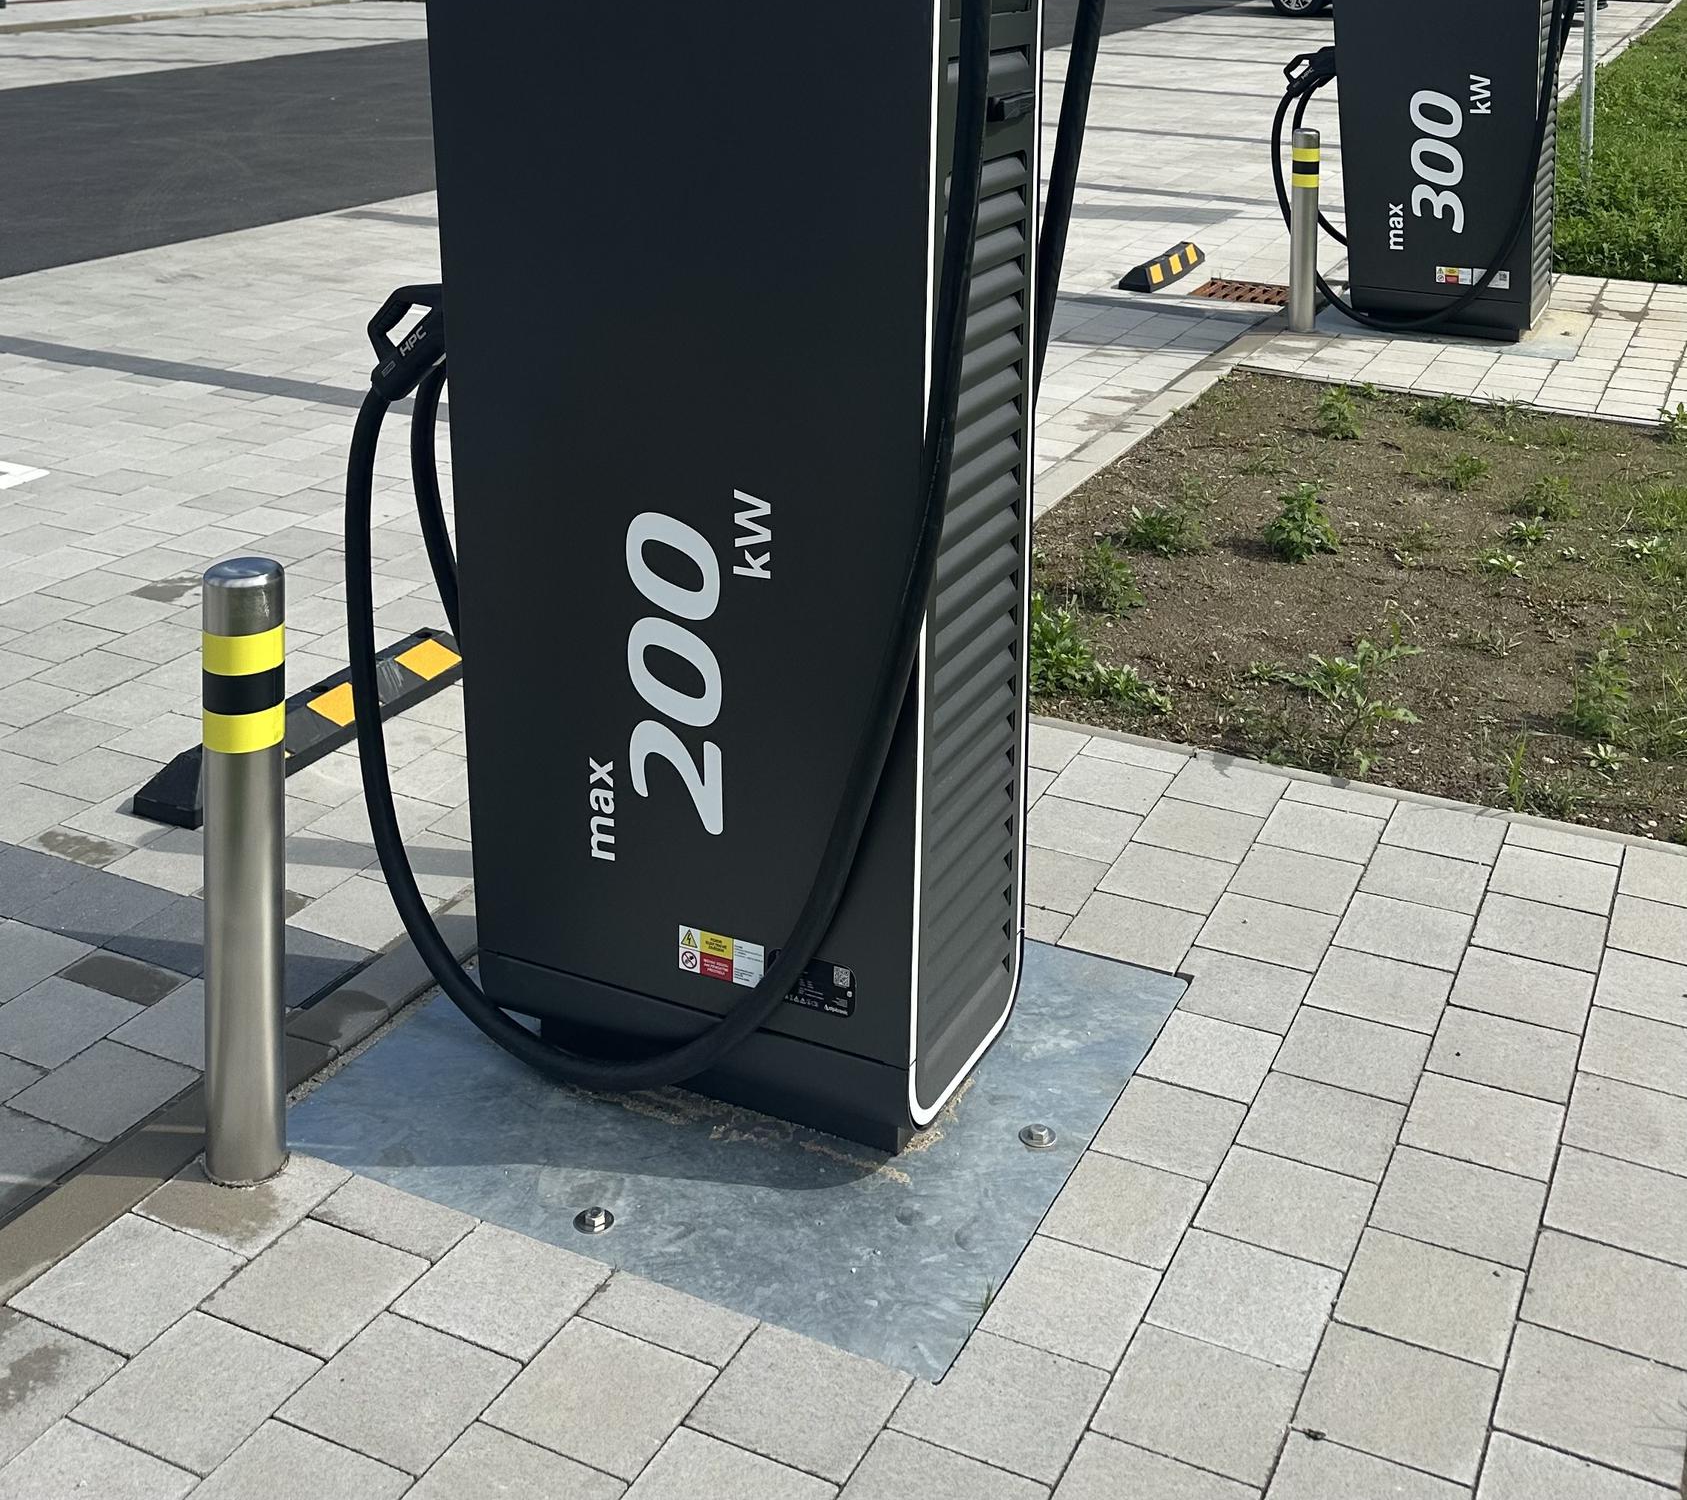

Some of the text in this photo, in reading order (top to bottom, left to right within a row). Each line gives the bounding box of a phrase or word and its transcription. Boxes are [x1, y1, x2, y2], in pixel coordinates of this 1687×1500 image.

[1469, 74, 1492, 115] kW
[1409, 90, 1465, 234] 300
[1388, 203, 1404, 251] max
[399, 325, 427, 357] HPC
[732, 489, 772, 579] kW
[626, 511, 723, 835] 200
[589, 757, 616, 861] max
